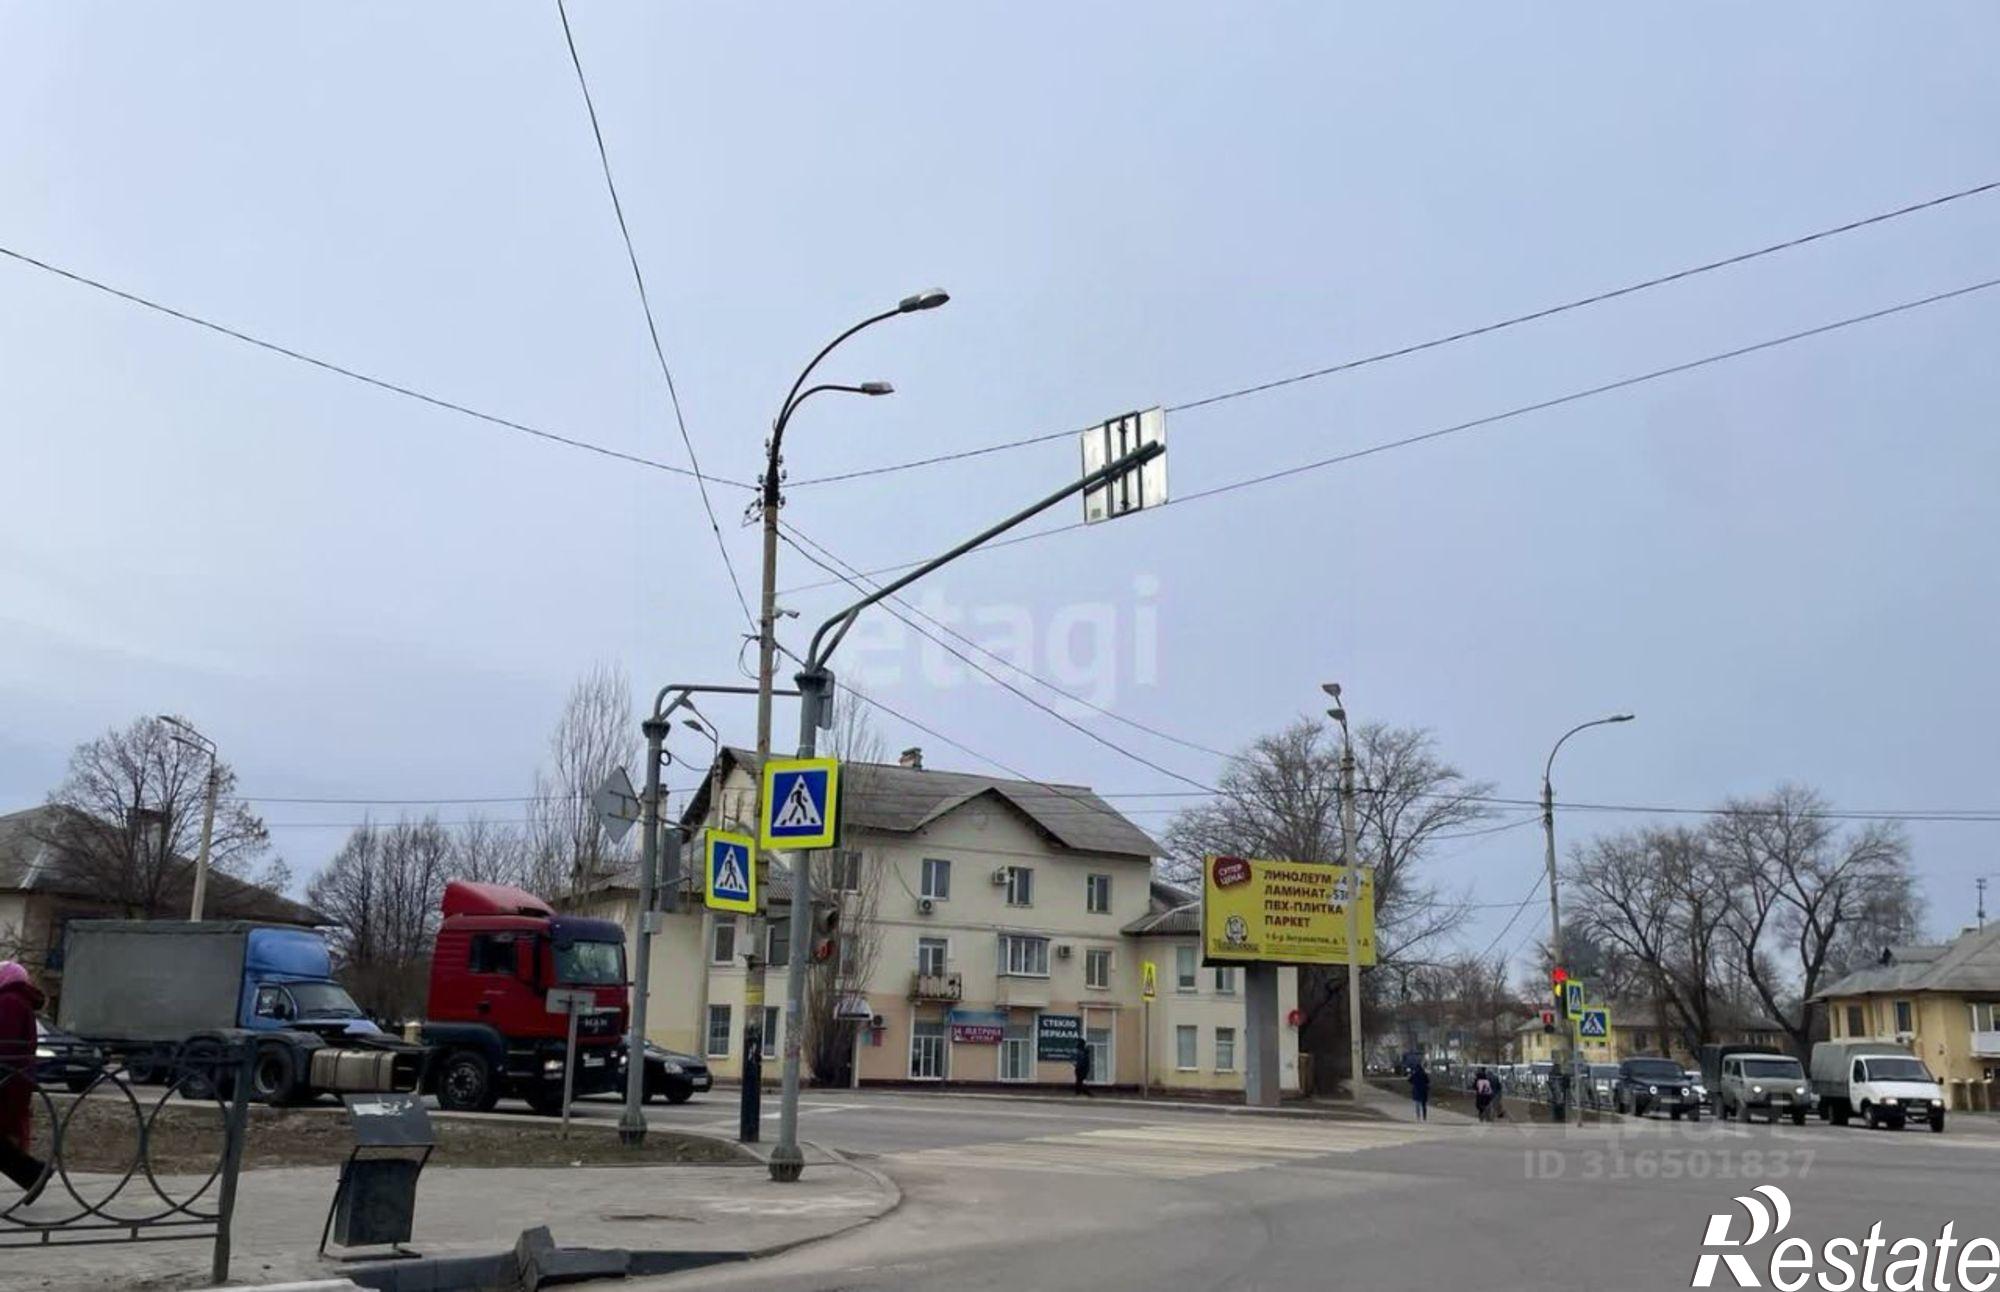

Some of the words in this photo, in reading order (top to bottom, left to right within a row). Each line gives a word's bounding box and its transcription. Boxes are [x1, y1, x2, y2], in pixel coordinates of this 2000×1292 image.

[1264, 870, 1332, 884] ЛИНОЛЕУМ
[1264, 885, 1326, 899] ЛАМИНАТ
[1264, 900, 1343, 915] ПВХ-ПЛИТКА
[1264, 915, 1310, 928] ПАРКЕТ
[1043, 1019, 1077, 1028] СТЕКЛО
[1040, 1029, 1079, 1039] ЗЕРКАЛА
